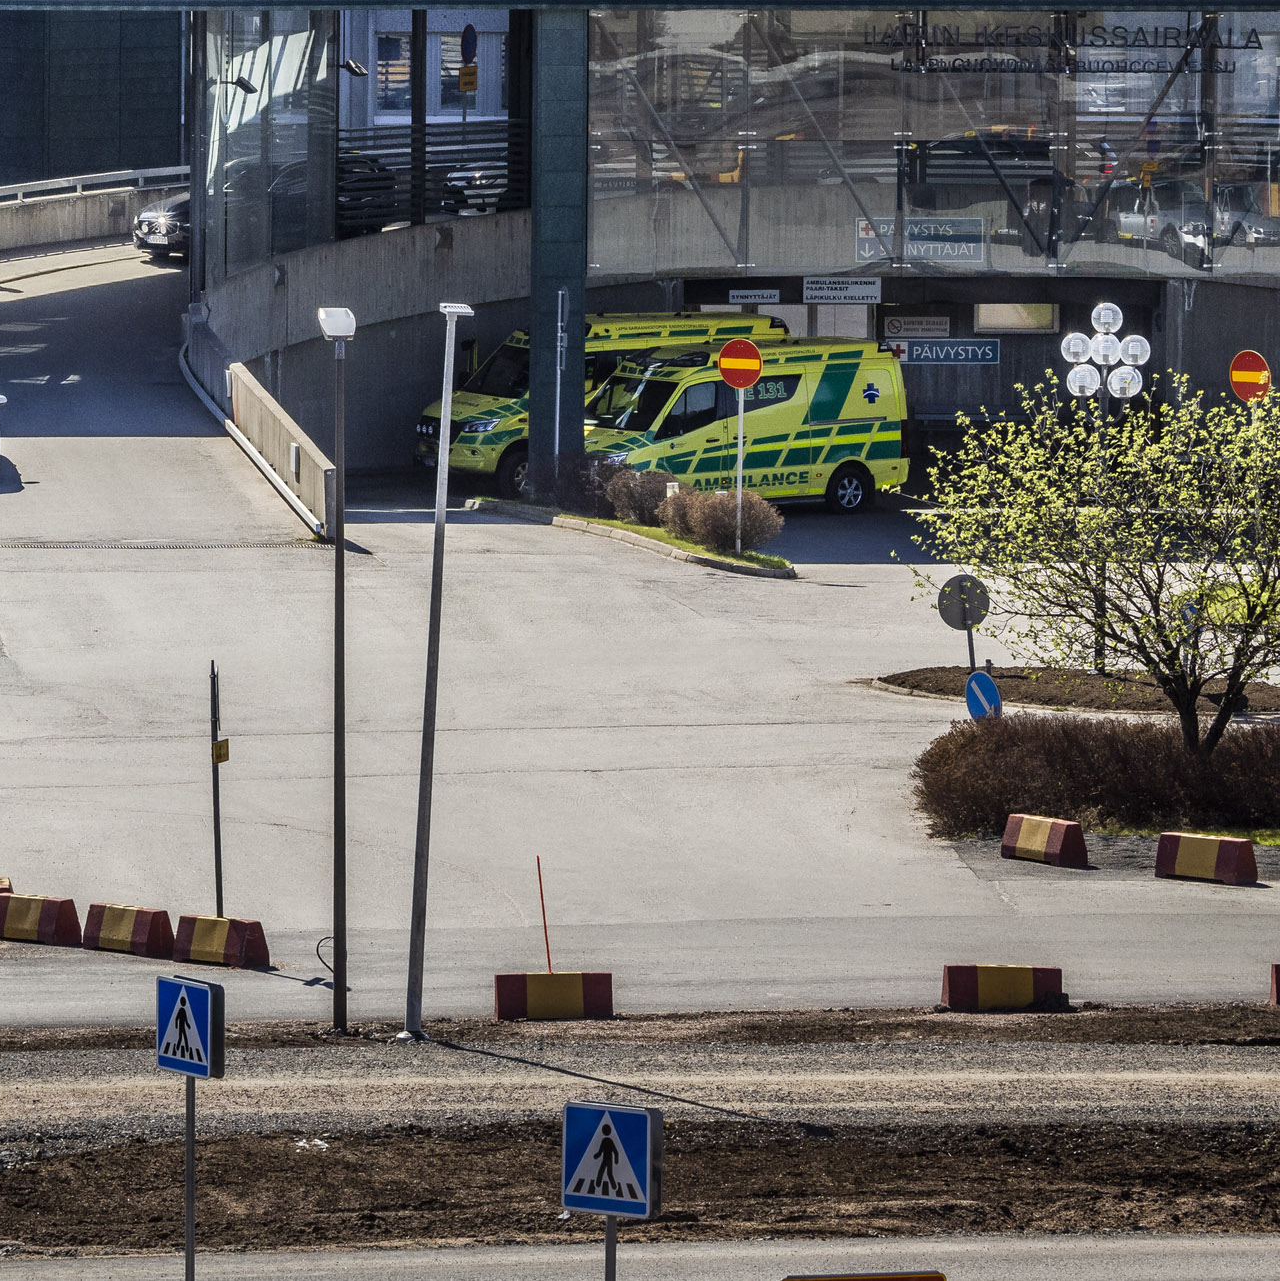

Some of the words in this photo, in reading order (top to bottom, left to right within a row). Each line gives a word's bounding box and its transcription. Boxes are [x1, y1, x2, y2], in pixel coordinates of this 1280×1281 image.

[983, 25, 1264, 51] KESKUSSAIRAALA
[880, 222, 953, 236] PÄVYSTYS
[913, 343, 993, 359] PÄIVYSTYS
[758, 381, 788, 400] 131
